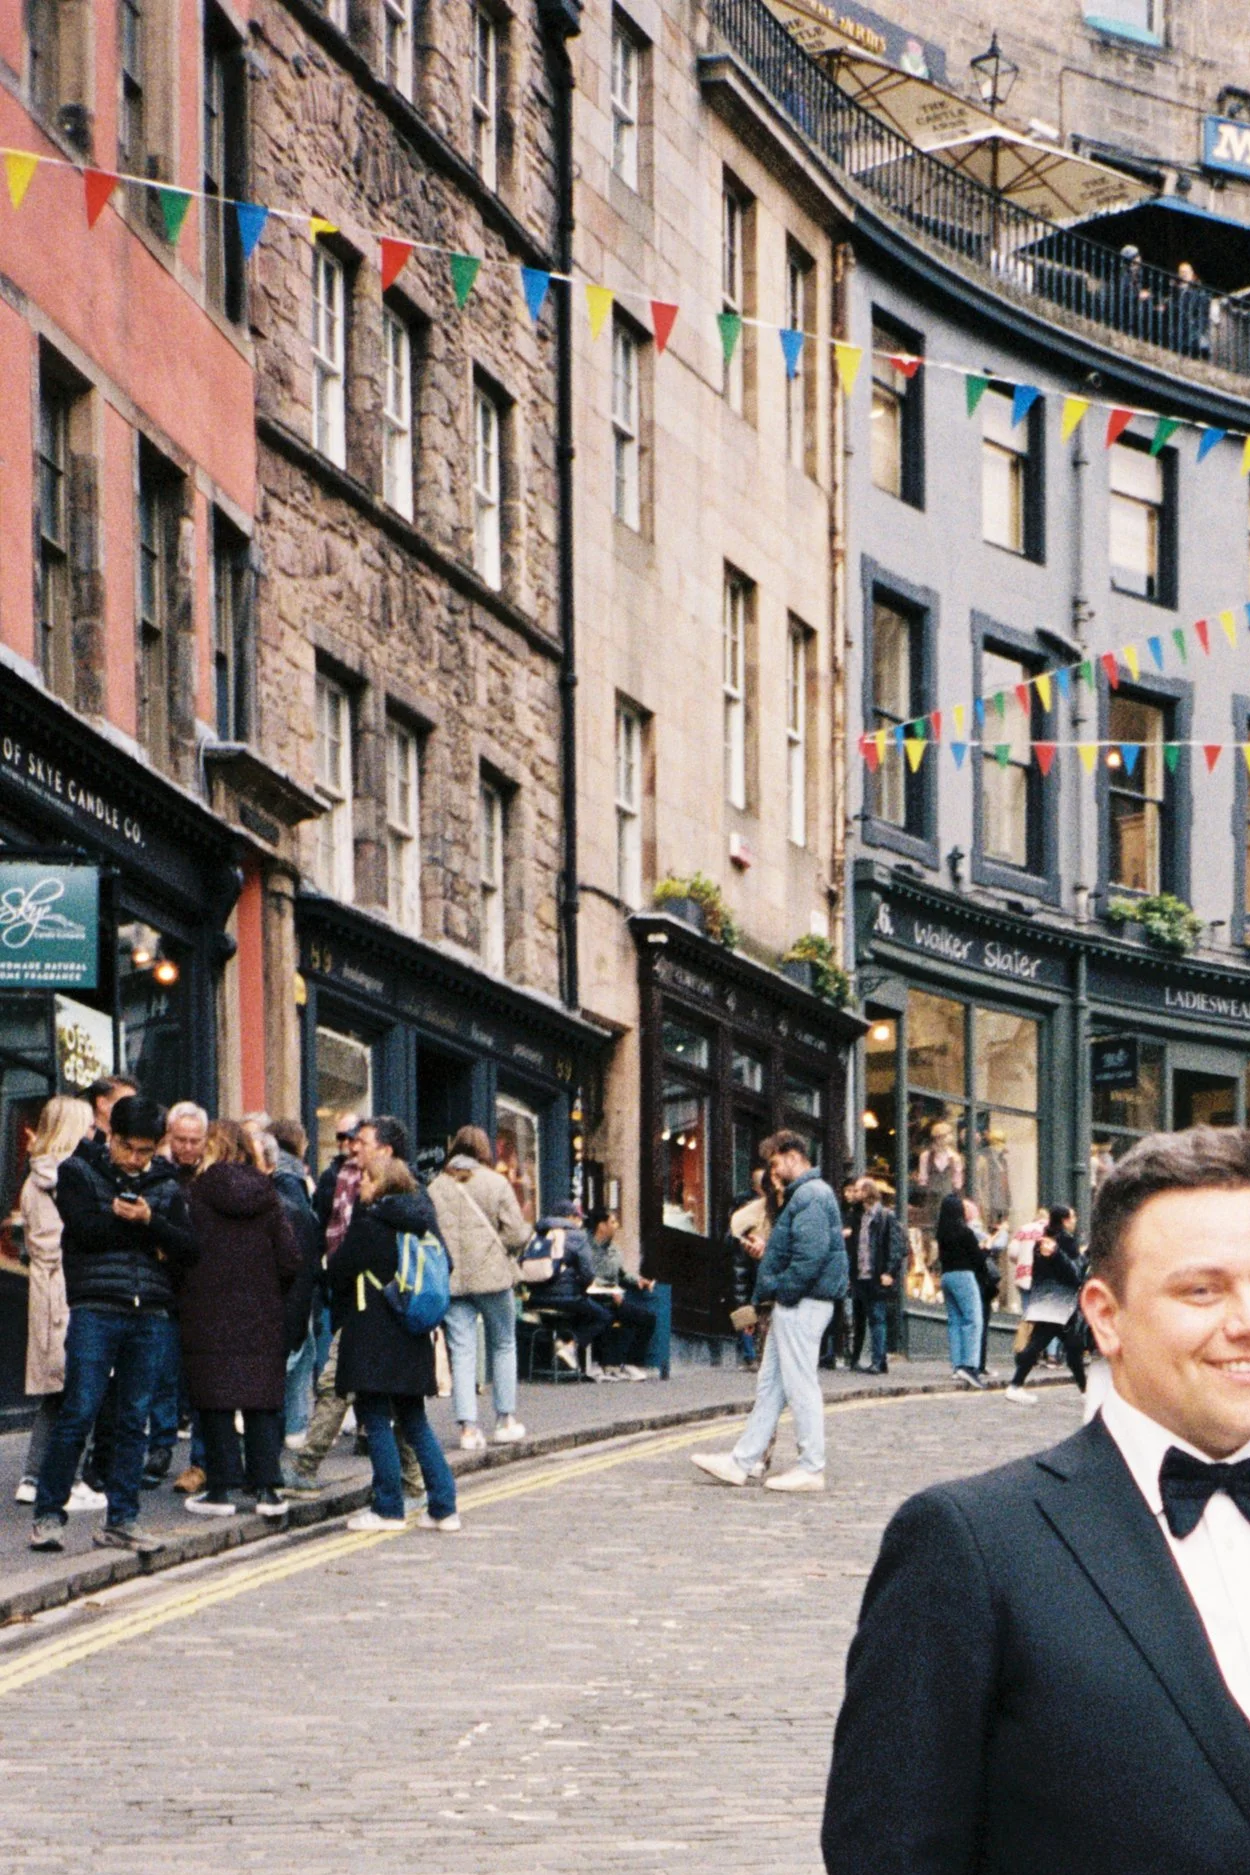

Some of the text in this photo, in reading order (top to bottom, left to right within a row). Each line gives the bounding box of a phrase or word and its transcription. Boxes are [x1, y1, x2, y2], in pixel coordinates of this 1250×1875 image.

[921, 101, 946, 113] THE
[915, 108, 966, 125] CASTLE
[3, 736, 21, 766] OF
[28, 752, 63, 794] SKYE
[68, 779, 119, 831] CANDLE
[123, 816, 146, 849] CO.
[913, 920, 1042, 978] Walker Slater
[44, 961, 88, 972] NATURAL
[24, 971, 82, 981] FRAGRANCE
